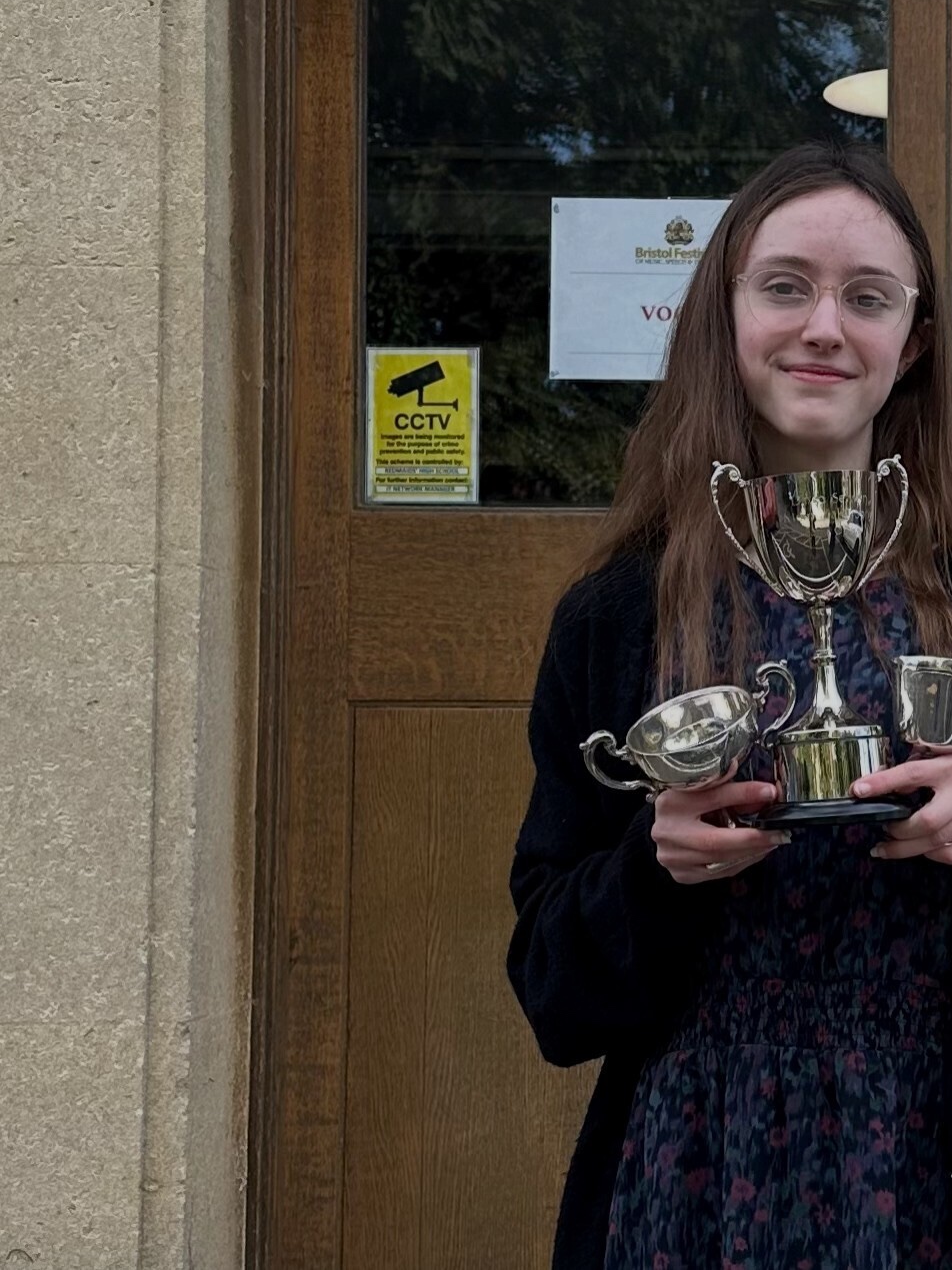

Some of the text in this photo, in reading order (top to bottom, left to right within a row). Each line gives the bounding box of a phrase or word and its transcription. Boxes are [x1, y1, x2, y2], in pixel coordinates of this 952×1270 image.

[635, 247, 672, 258] Bristol
[640, 305, 672, 321] VO
[394, 413, 451, 430] CCTV
